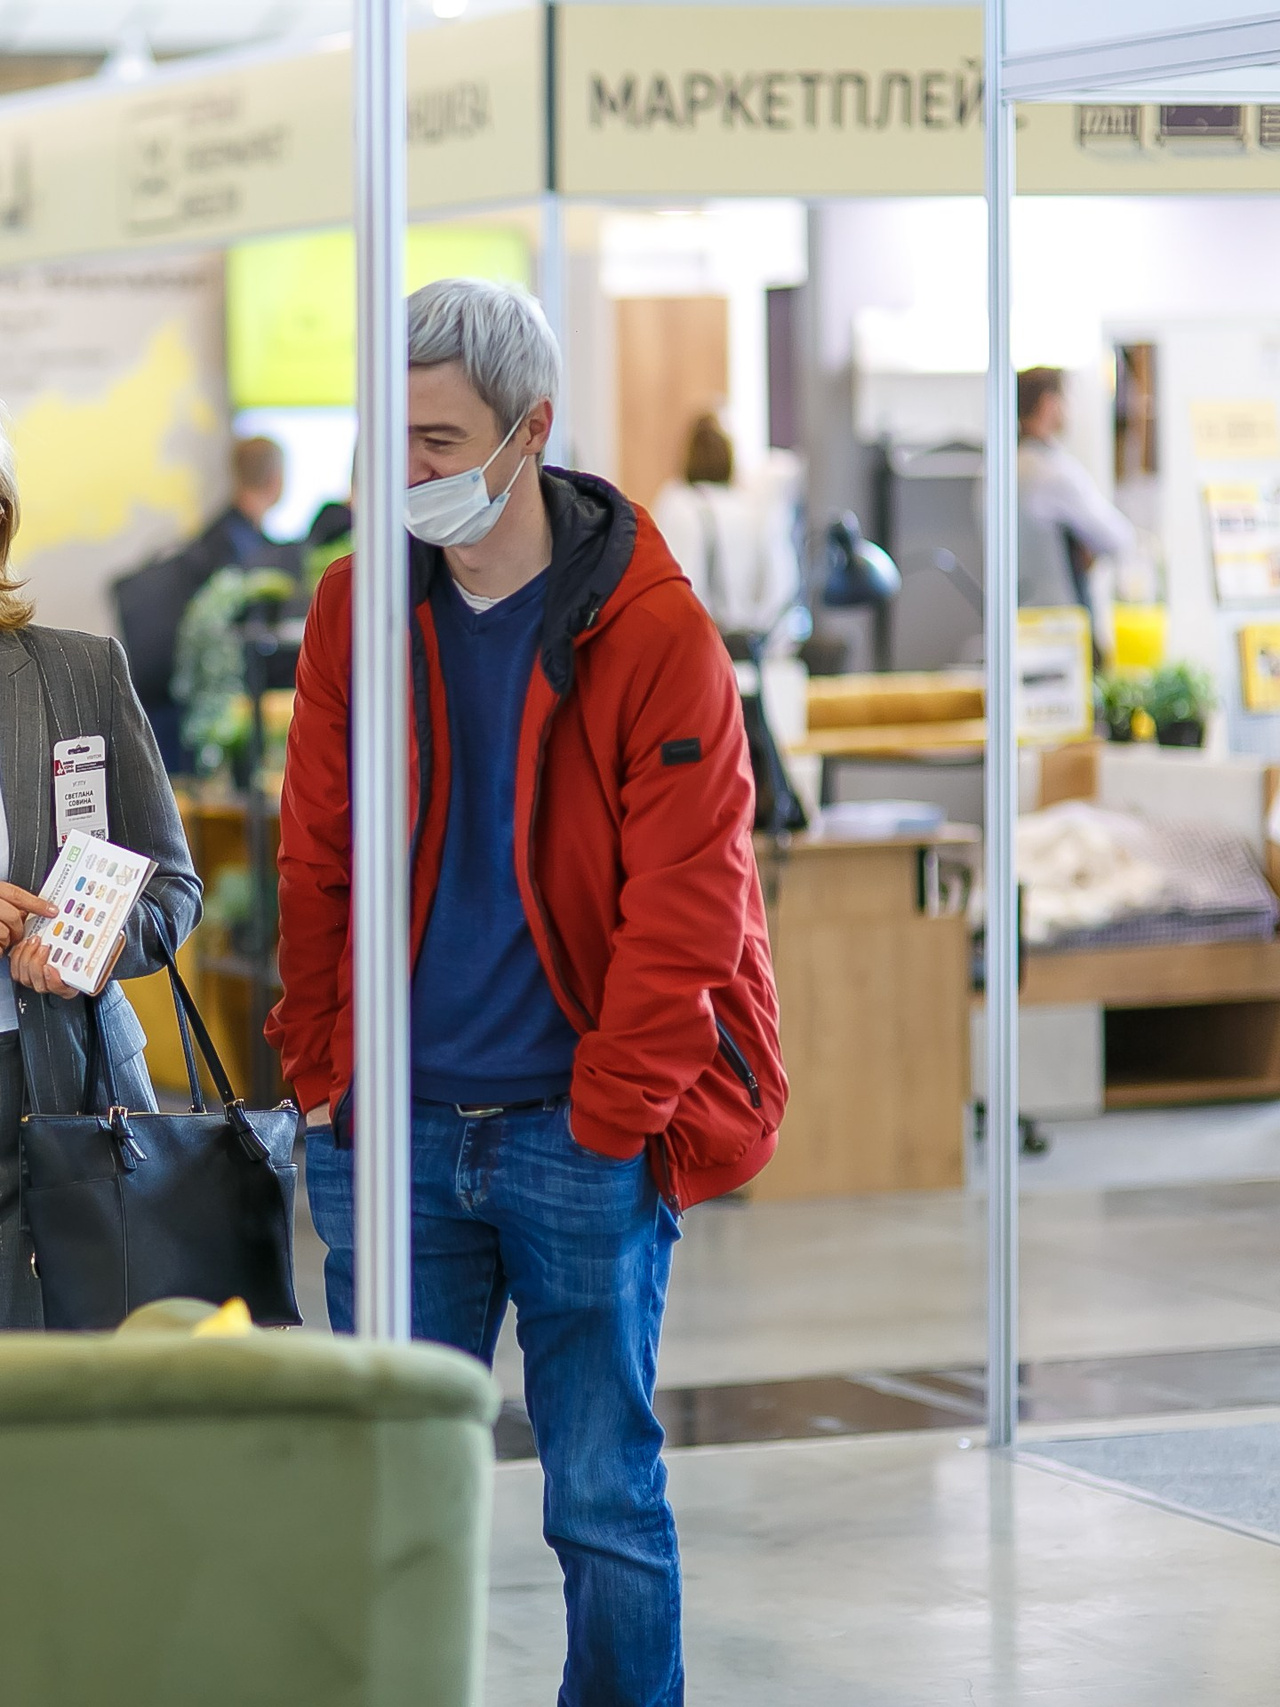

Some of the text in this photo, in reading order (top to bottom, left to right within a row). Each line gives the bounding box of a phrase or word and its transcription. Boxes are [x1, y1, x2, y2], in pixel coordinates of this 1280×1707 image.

[589, 57, 1029, 129] МАРКЕТПЛЕЙ
[64, 790, 94, 800] СВЕТЛАНА
[68, 798, 92, 807] СОВИНА
